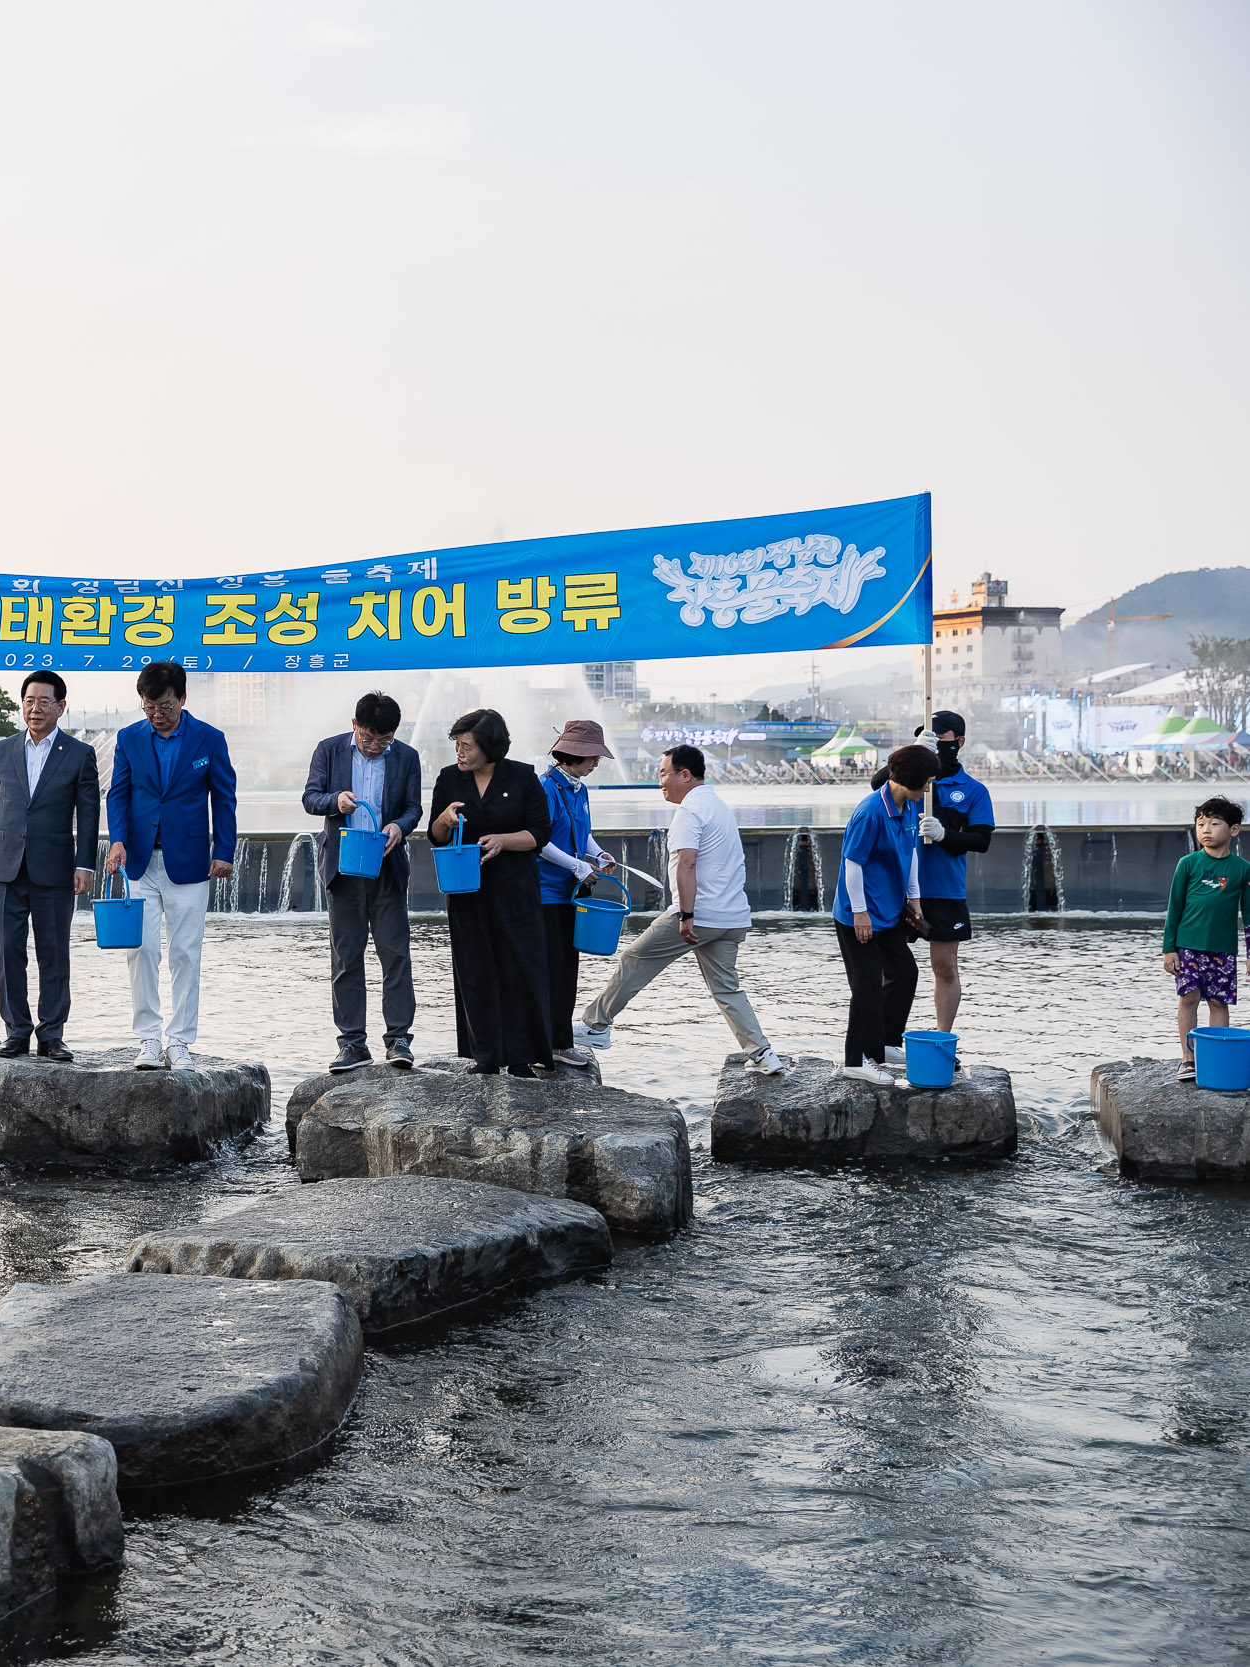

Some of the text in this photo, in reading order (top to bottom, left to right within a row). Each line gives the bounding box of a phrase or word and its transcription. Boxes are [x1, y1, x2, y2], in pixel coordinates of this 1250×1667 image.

[691, 534, 841, 576] 제16회 정남진
[201, 592, 321, 646] 조성
[347, 582, 467, 641] 치어
[496, 572, 621, 634] 방류
[83, 654, 102, 667] 7.
[284, 653, 350, 669] 장흥군
